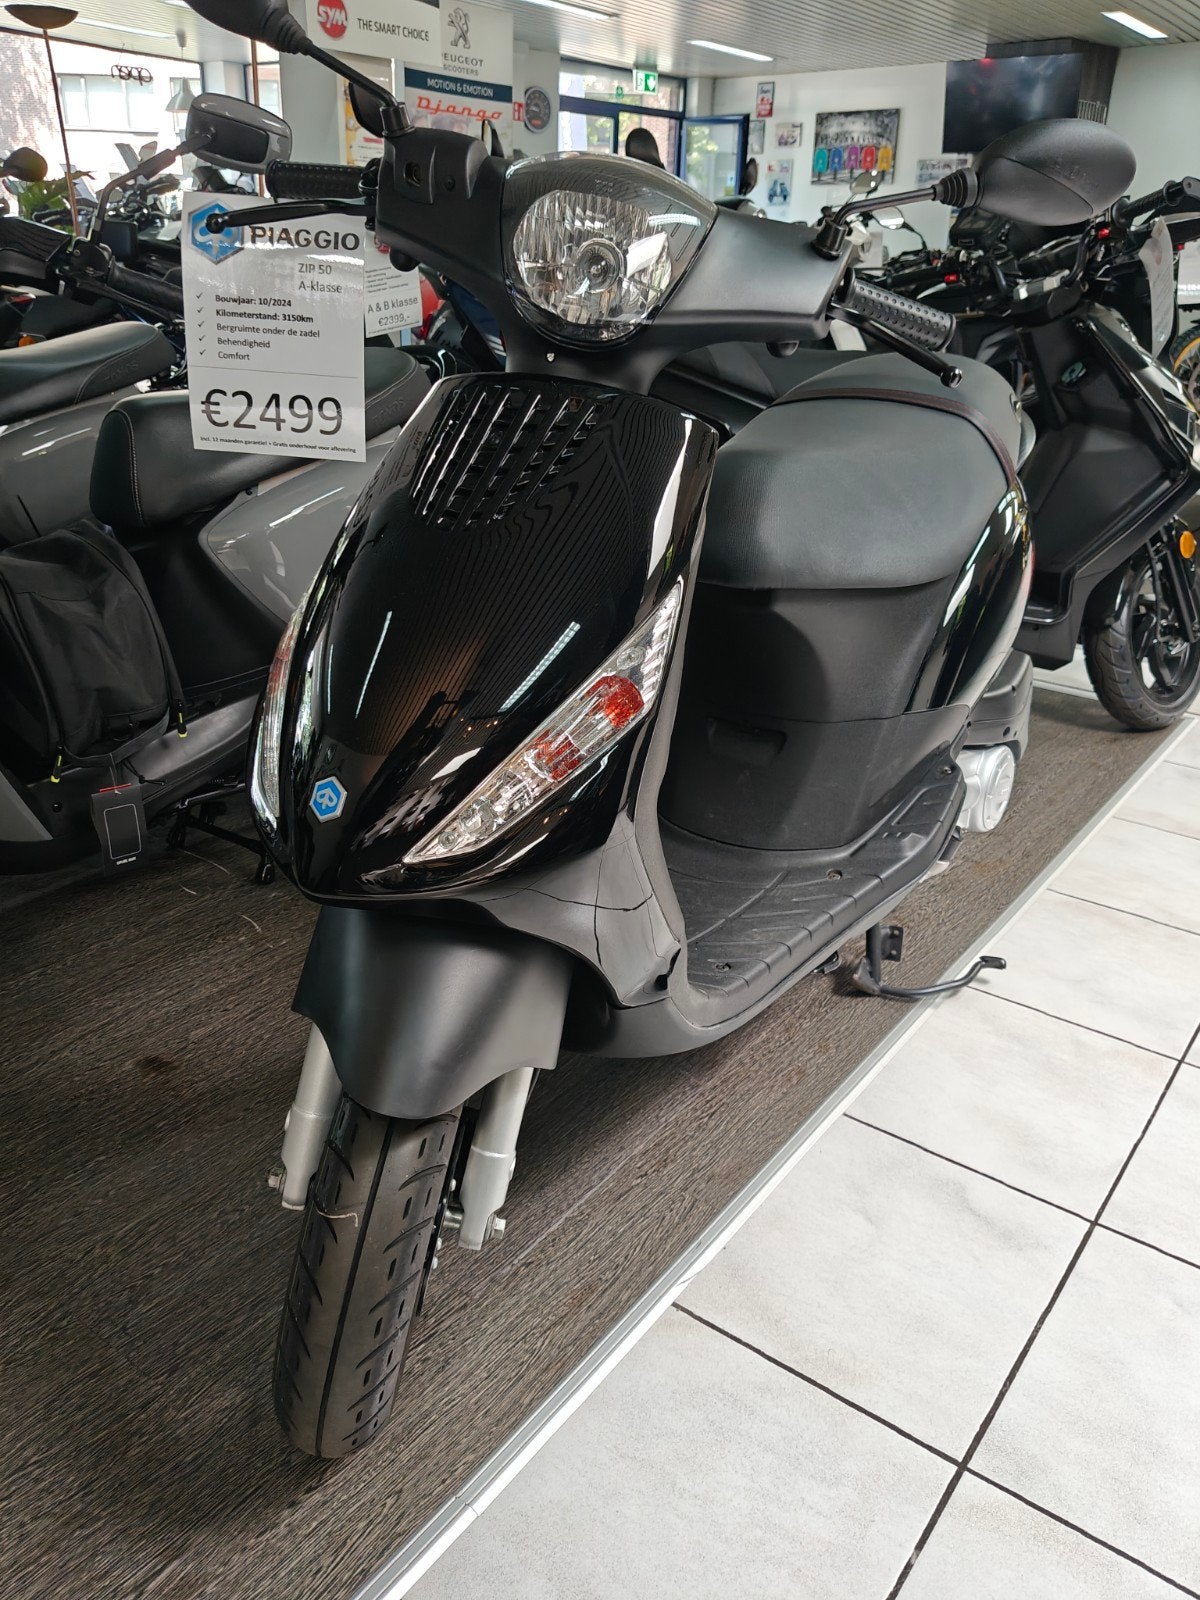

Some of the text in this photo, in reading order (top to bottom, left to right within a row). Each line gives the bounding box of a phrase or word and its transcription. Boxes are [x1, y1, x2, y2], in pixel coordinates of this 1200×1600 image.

[318, 6, 347, 28] SYM
[357, 18, 429, 41] THE SMART CHOICE
[442, 53, 484, 67] EUGEOT
[443, 64, 479, 76] SCOOTERS
[427, 78, 494, 97] MOTION & EMOTION
[417, 96, 503, 121] Django
[249, 225, 360, 251] PIAGGIO
[298, 263, 332, 275] ZIP 50
[299, 281, 342, 294] A-klasse
[215, 294, 292, 308] Bouwjaar: 10/2024
[367, 297, 418, 314] A & B klasse
[216, 309, 314, 323] Kilometerstand: 3150km
[216, 323, 320, 338] Bergruimte onder de zadel
[217, 337, 271, 349] Behendigheid
[218, 351, 250, 361] Comfort
[201, 388, 343, 436] €2499
